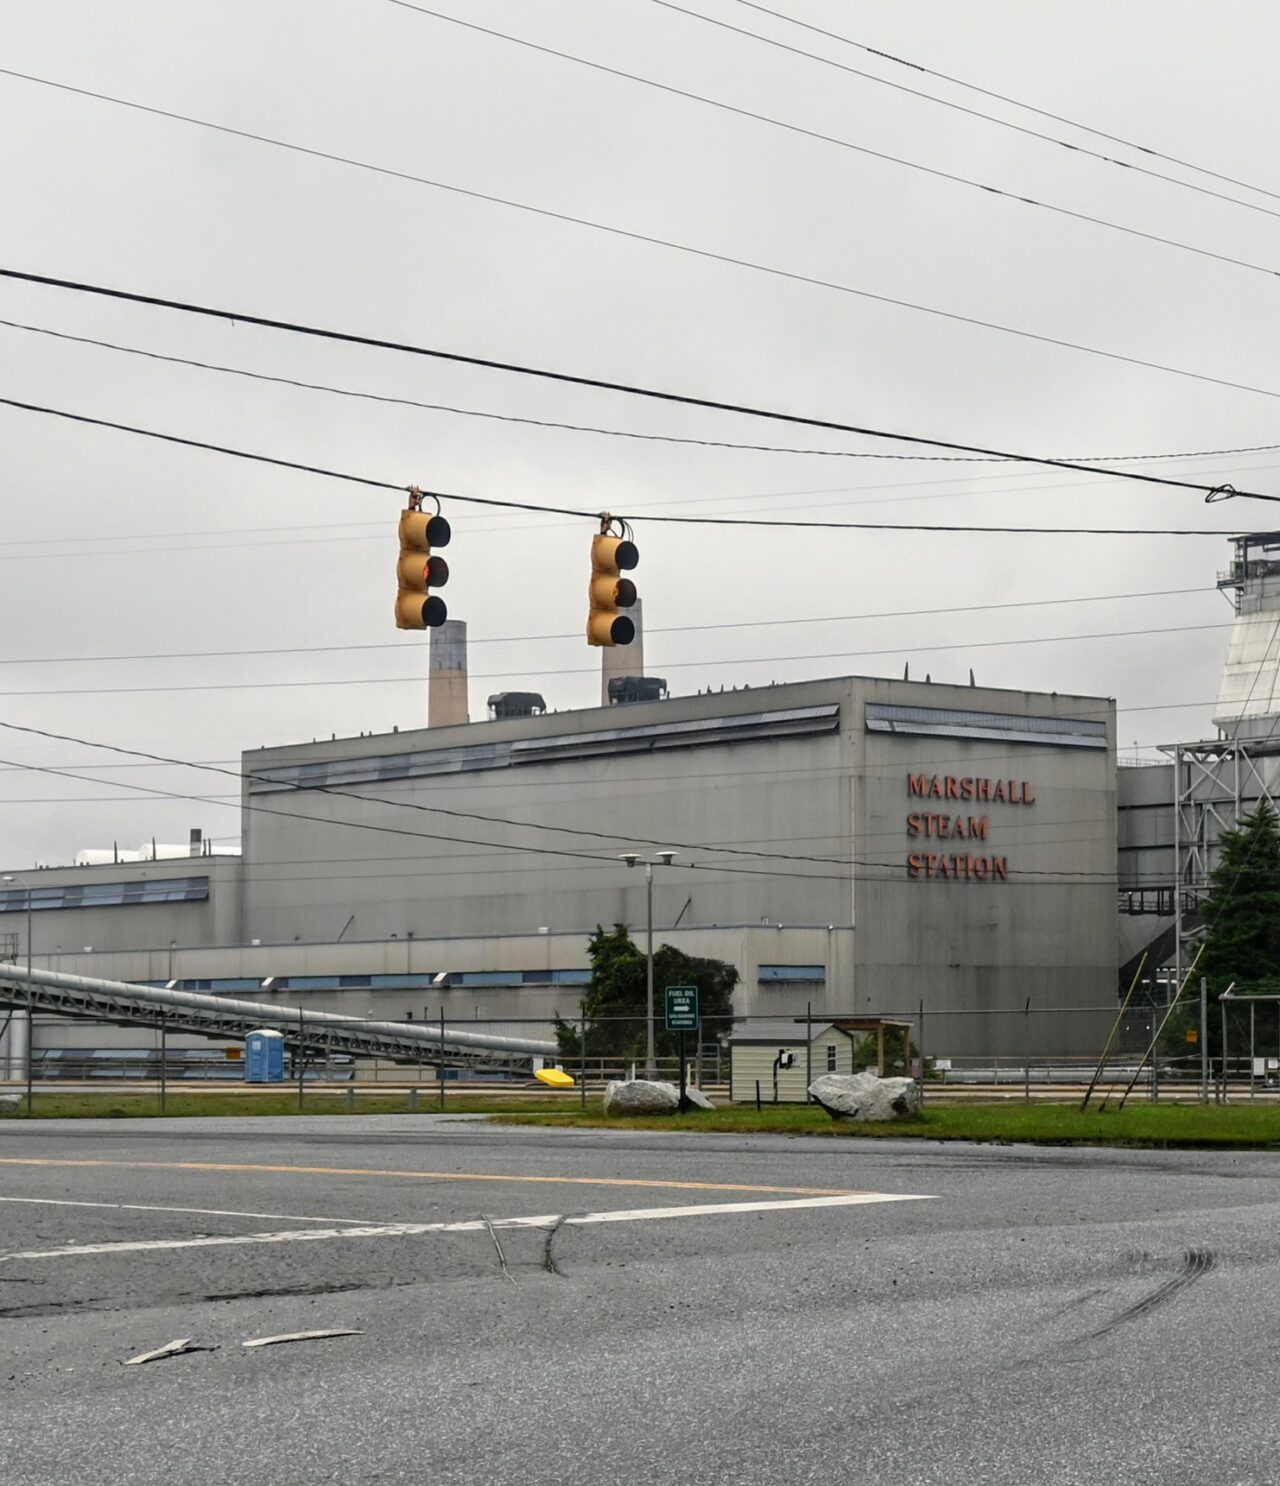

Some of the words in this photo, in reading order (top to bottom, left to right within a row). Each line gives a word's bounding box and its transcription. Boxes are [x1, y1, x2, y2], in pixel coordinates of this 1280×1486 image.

[907, 773, 1036, 804] MARSHALL
[907, 812, 989, 840] STEAM
[907, 851, 1009, 881] STATION
